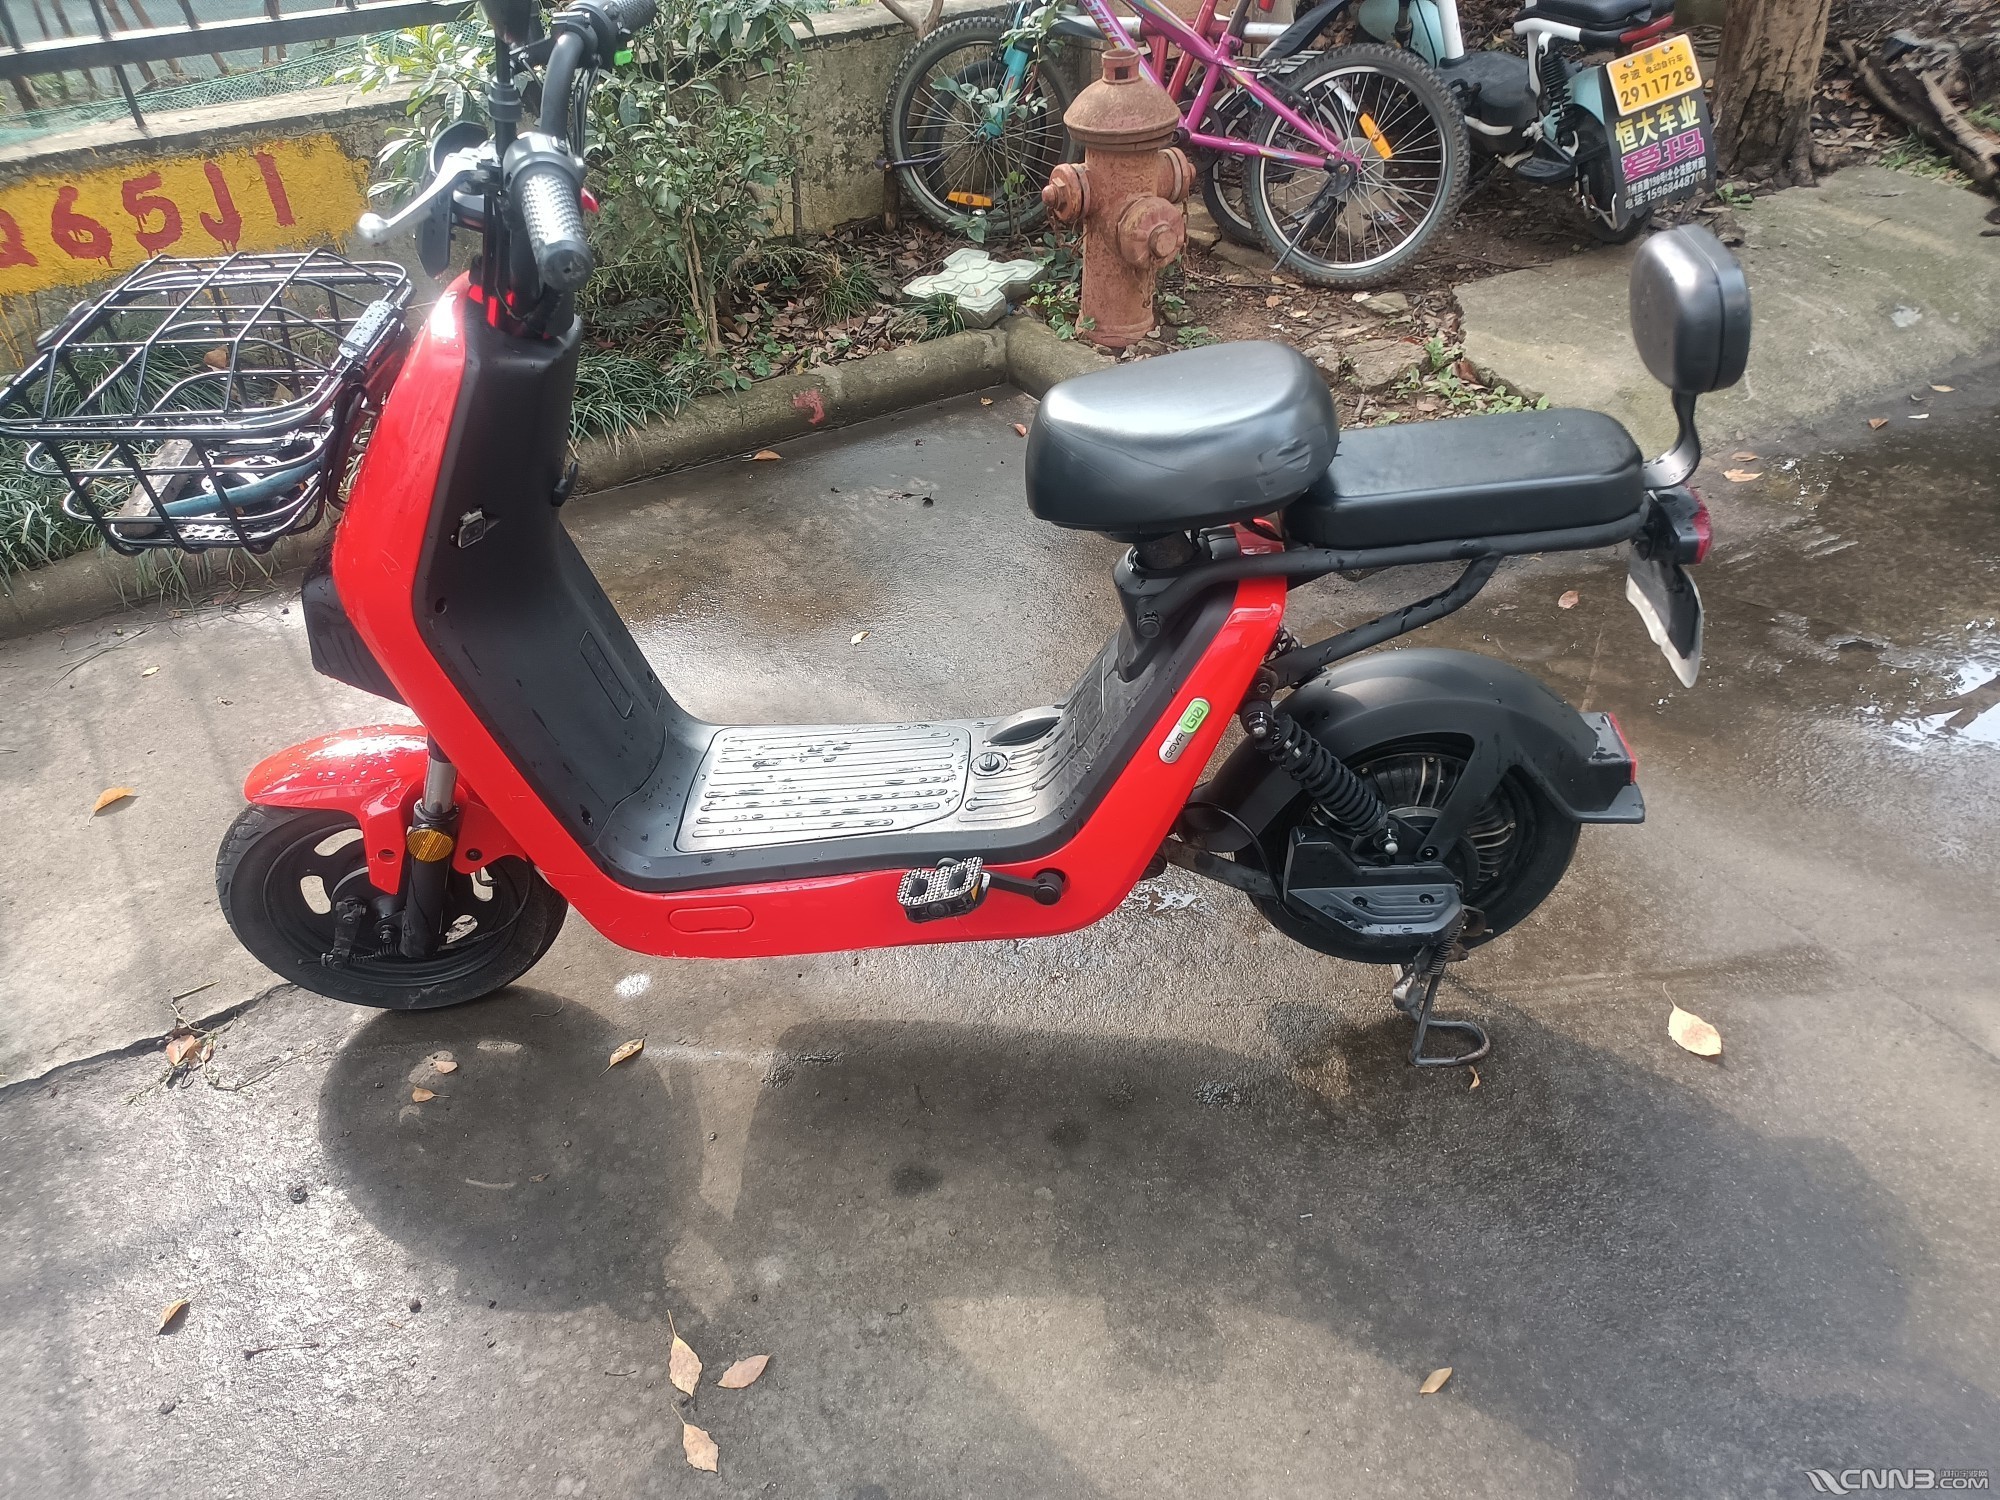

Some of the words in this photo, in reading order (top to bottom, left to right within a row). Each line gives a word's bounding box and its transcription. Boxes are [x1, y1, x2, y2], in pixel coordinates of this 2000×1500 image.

[1620, 69, 1641, 84] 宁波
[1646, 54, 1684, 74] 电动自行车
[1621, 65, 1695, 107] 2911728
[1615, 95, 1701, 154] 恒大车业
[1621, 127, 1705, 184] 爱玛
[1165, 733, 1185, 758] GOVA
